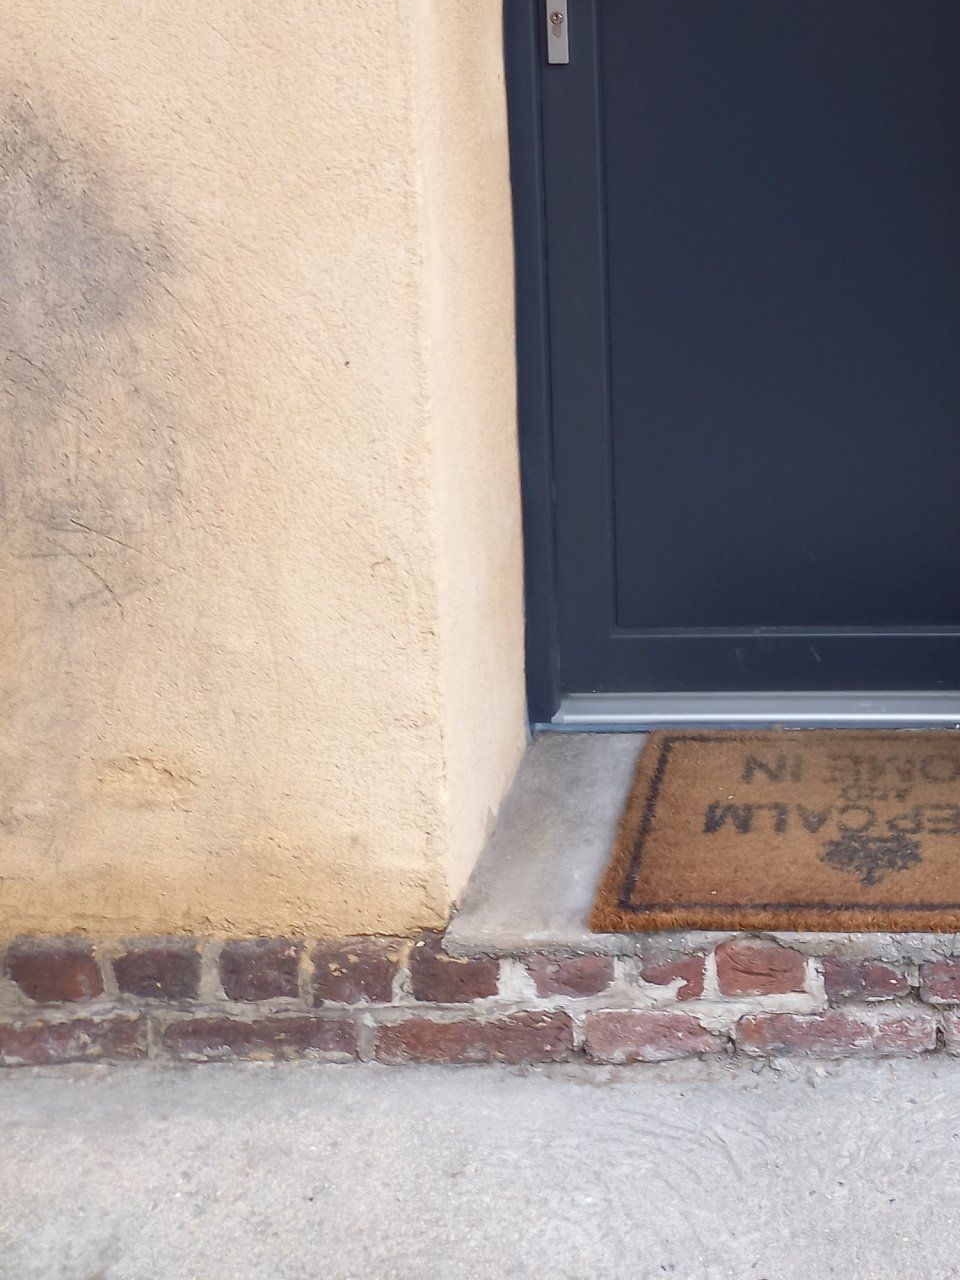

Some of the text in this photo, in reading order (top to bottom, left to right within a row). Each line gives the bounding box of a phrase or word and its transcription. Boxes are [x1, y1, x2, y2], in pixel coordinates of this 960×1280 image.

[741, 753, 803, 784] IN
[839, 783, 908, 802] AND
[702, 801, 877, 835] CALM
